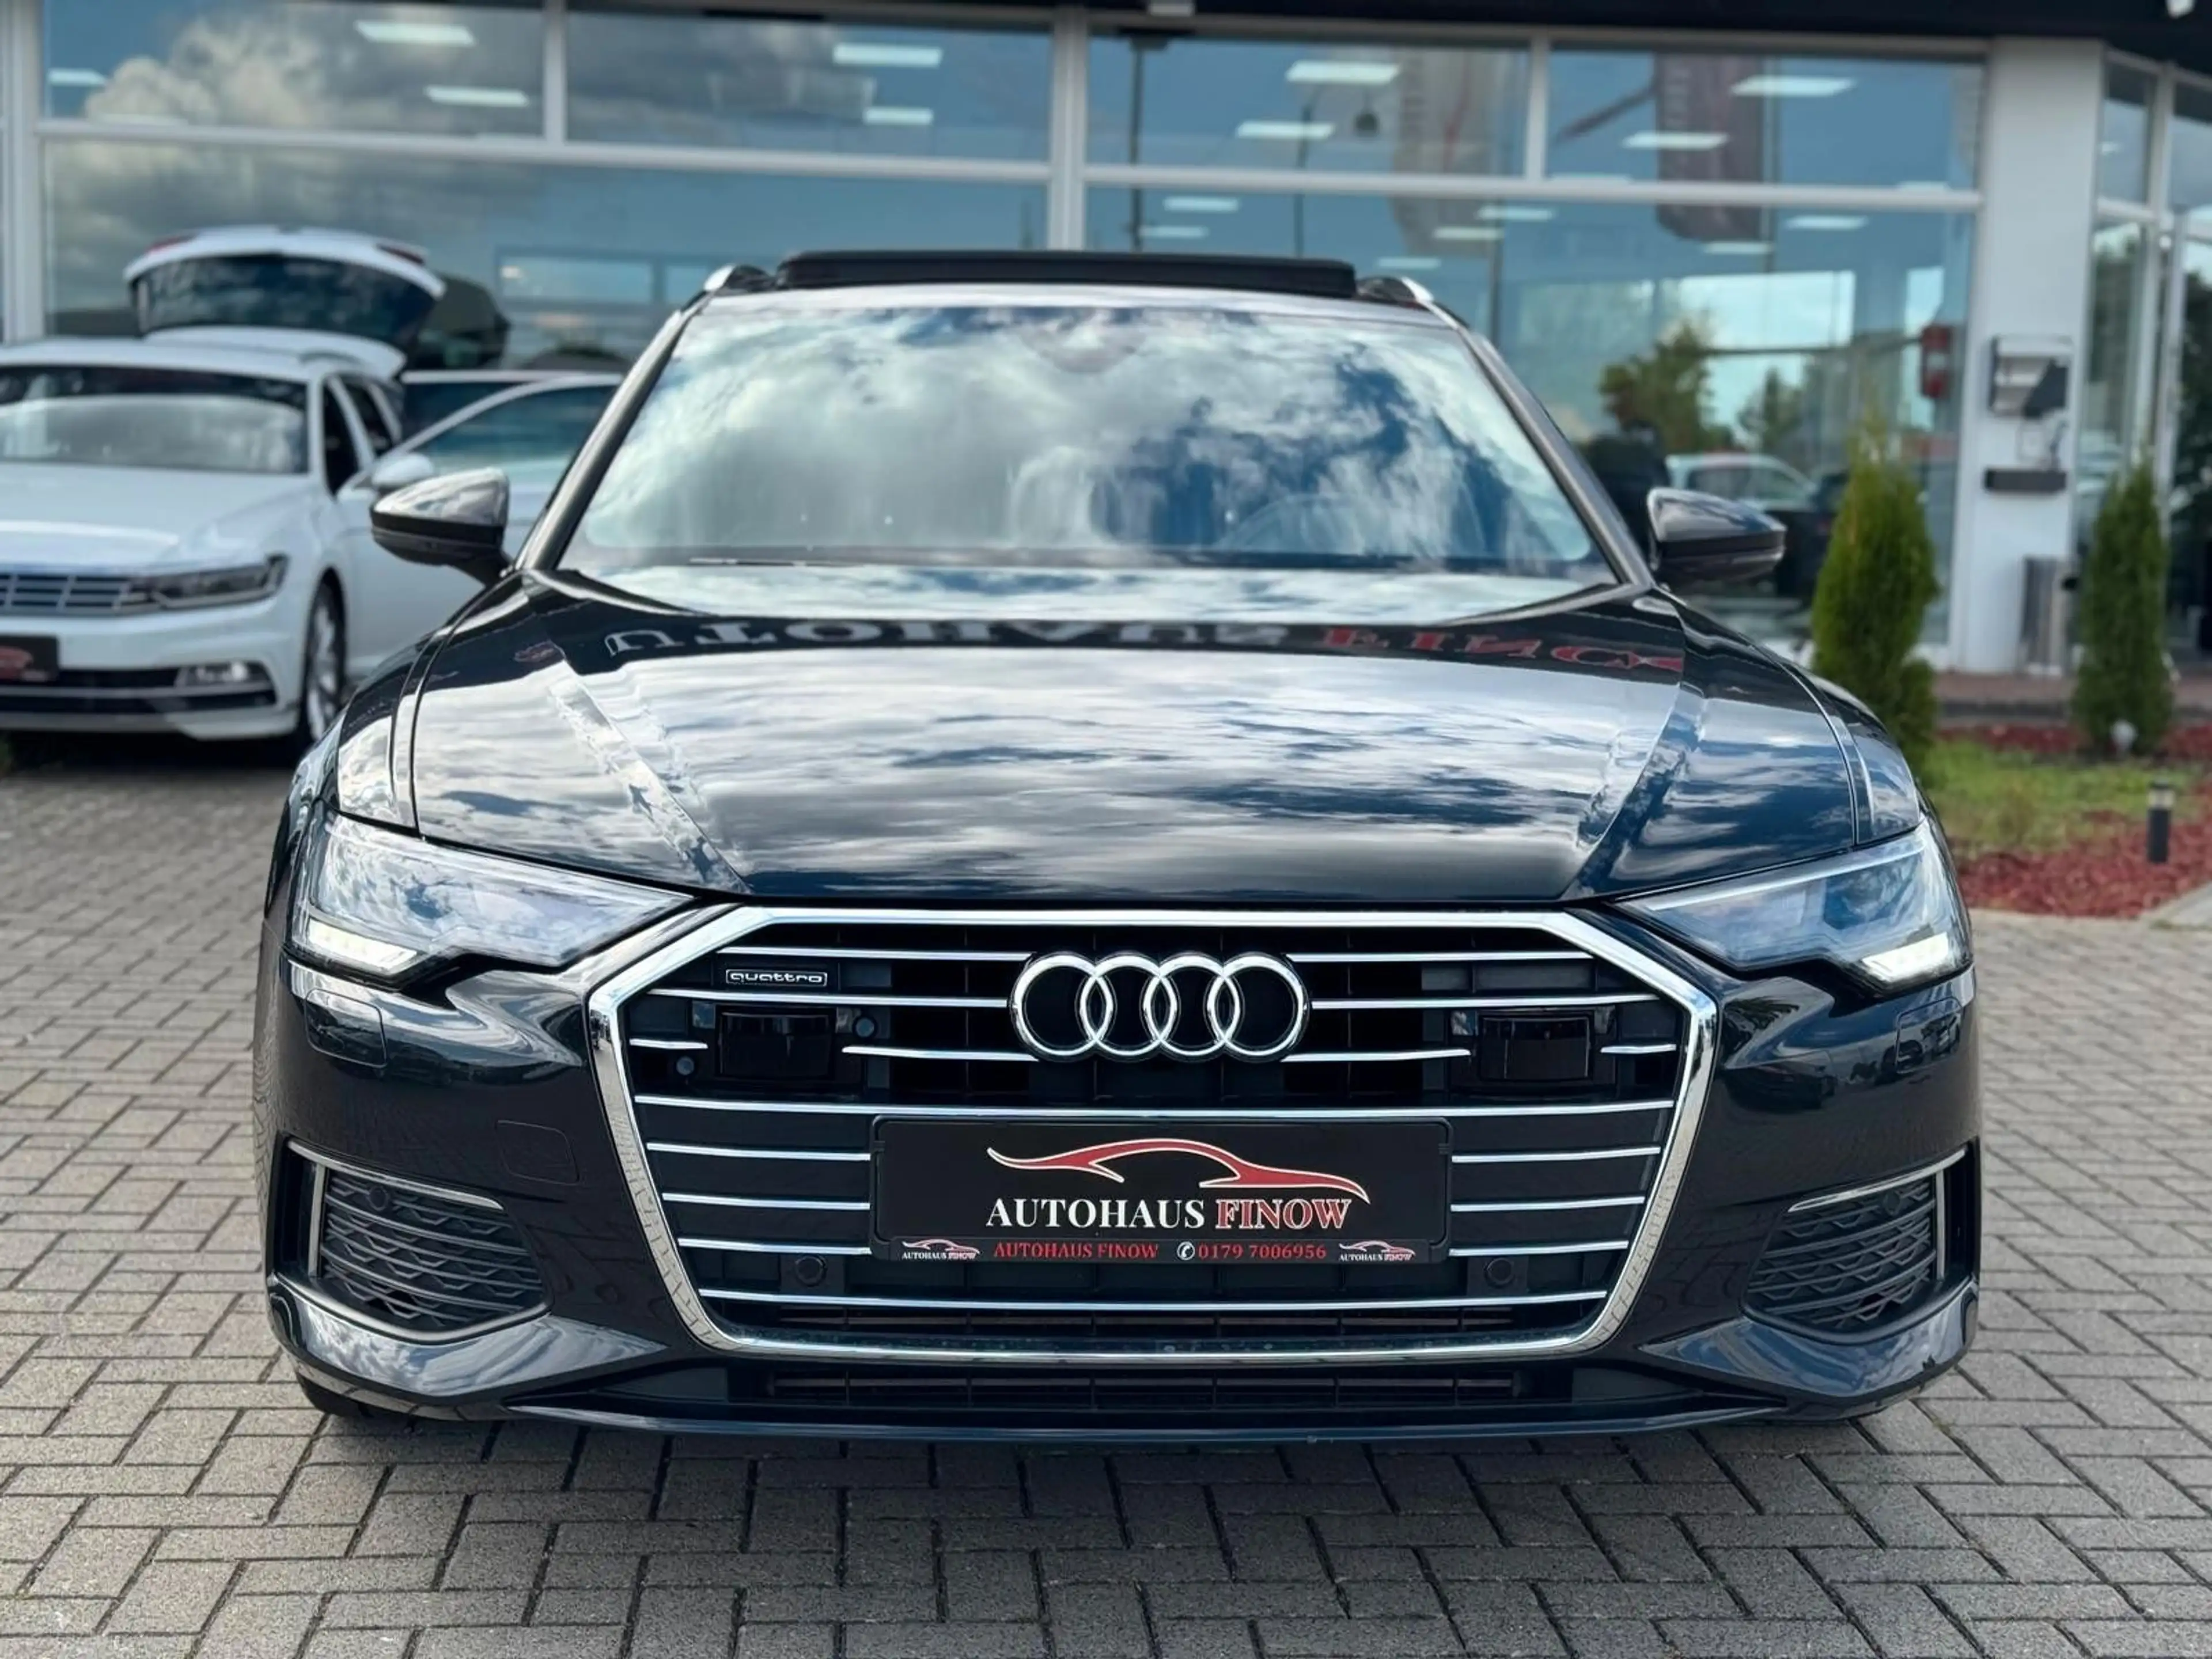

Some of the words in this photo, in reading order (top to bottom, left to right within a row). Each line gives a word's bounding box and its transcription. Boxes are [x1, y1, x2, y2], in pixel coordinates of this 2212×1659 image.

[730, 972, 824, 983] quattro
[986, 1199, 1205, 1229] AUTOHAUS
[1215, 1199, 1352, 1229] FINOW
[902, 1252, 946, 1260] AUTOHAUS
[994, 1242, 1092, 1258] AUTOHAUS
[1098, 1243, 1159, 1258] FINOW
[1198, 1244, 1244, 1259] 0179
[1249, 1244, 1327, 1259] 7006956
[1339, 1253, 1382, 1262] AUTOHAUS
